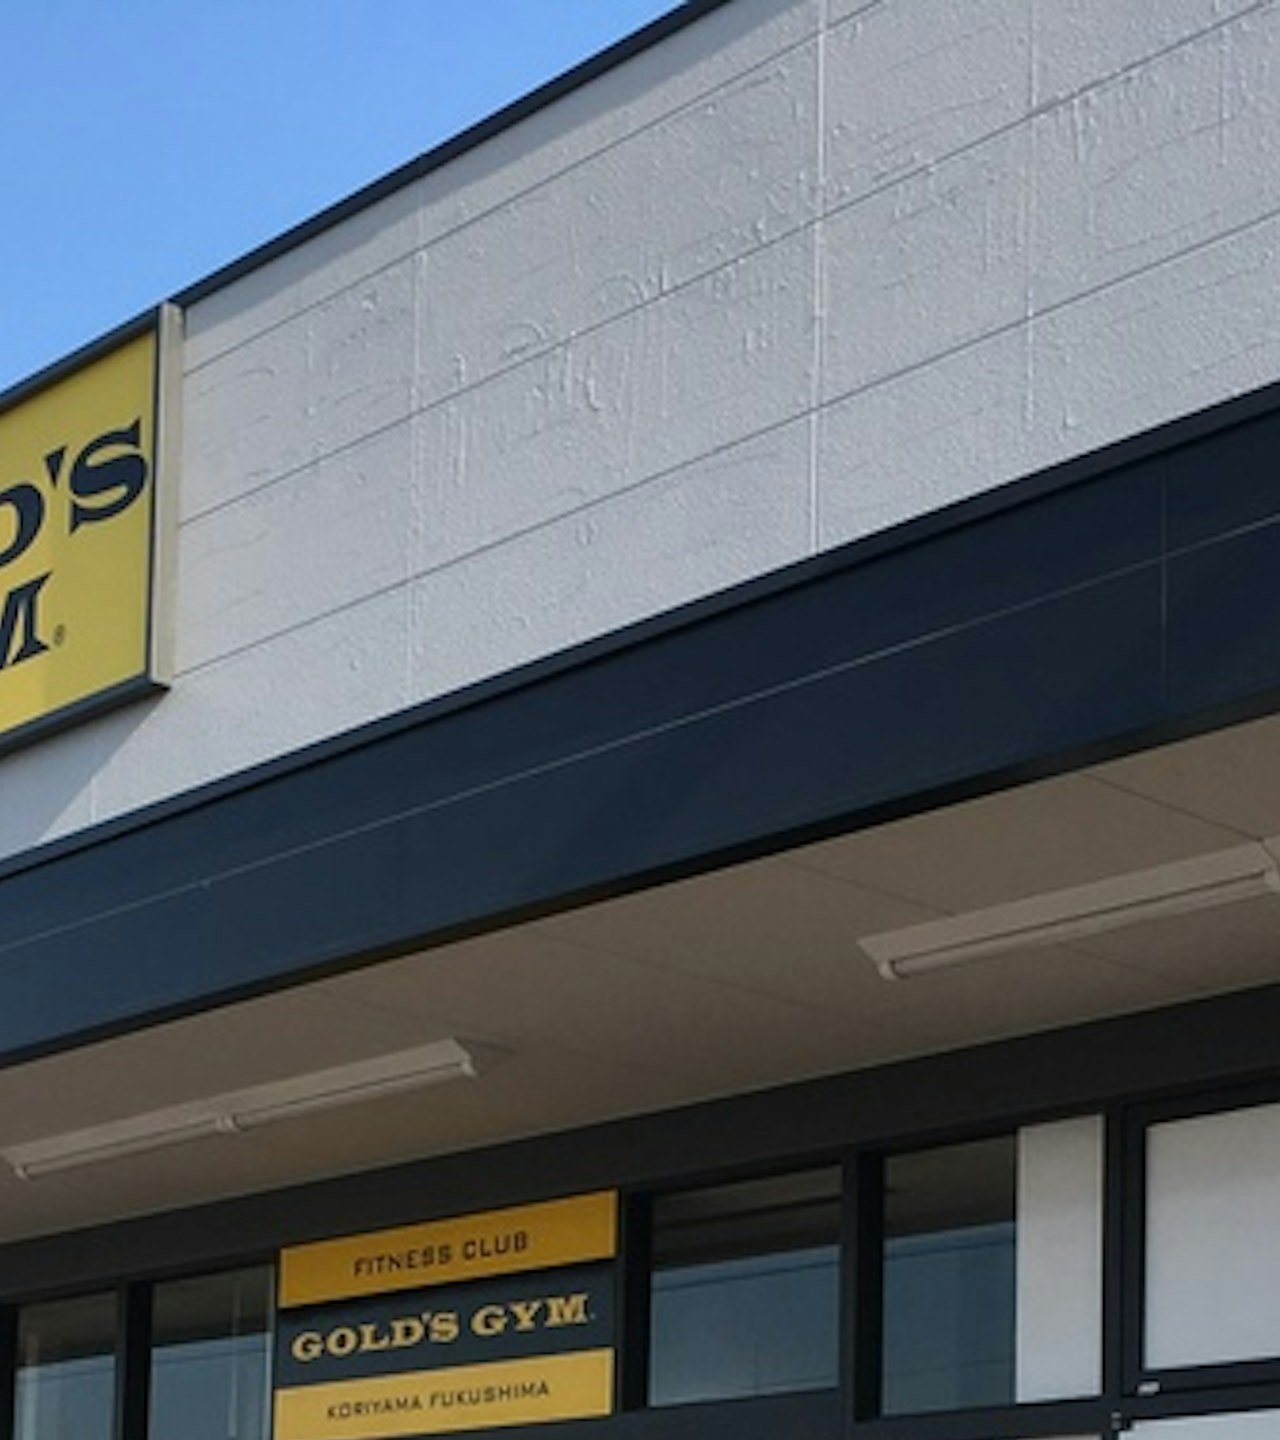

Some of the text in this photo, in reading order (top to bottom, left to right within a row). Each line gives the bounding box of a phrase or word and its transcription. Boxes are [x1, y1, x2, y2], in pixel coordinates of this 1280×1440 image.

[353, 1230, 531, 1277] FITNESS CLUB
[291, 1293, 590, 1362] GOLD'S GYM
[327, 1379, 550, 1420] KORIYAMA FUKUSHIMA
